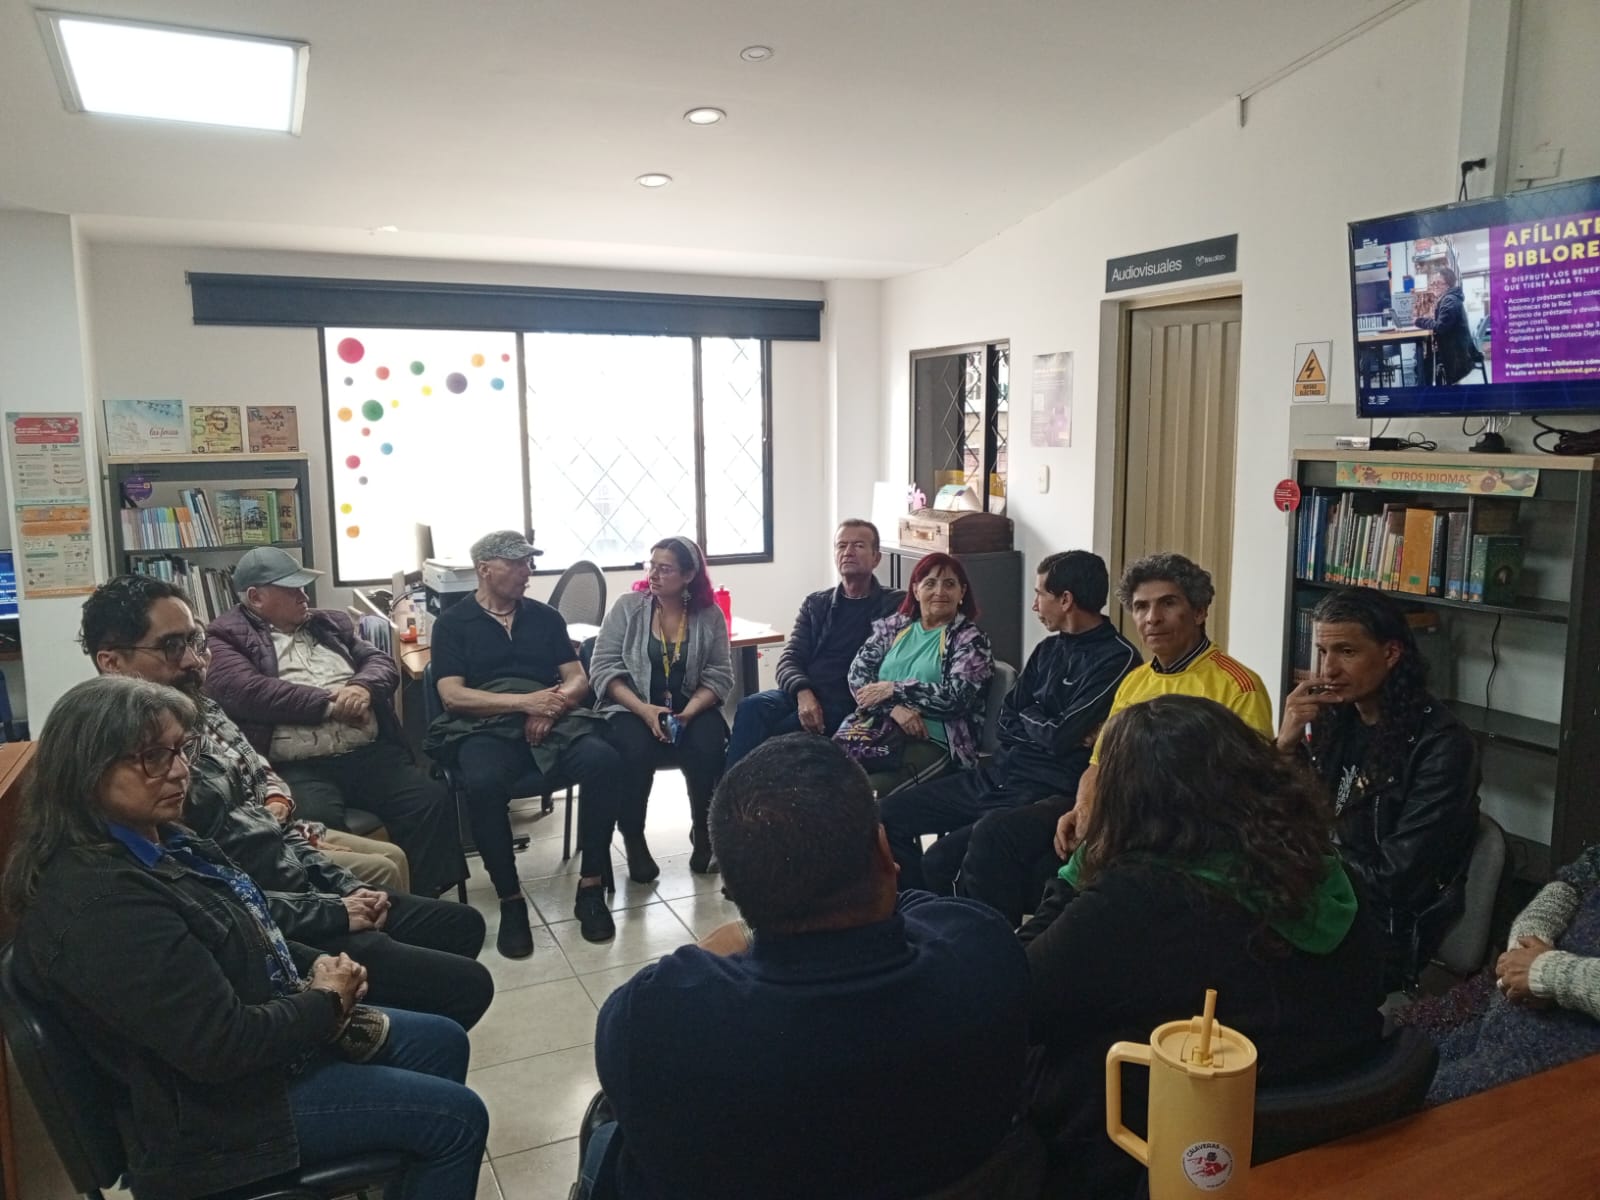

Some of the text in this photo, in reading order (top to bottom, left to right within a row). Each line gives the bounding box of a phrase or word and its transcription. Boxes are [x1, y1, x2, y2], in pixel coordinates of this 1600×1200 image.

[1504, 240, 1600, 269] BIBLORE
[1111, 259, 1182, 282] Audiovisuales
[1511, 273, 1550, 283] DISFRUTA
[1553, 270, 1570, 278] LOS
[1504, 284, 1520, 292] QUE
[1523, 280, 1546, 289] TIENE
[1549, 278, 1571, 286] PARA
[1508, 311, 1532, 319] Servicio
[1550, 331, 1582, 339] Biblioteca
[1391, 471, 1472, 484] OTROS IDIOMAS
[1186, 1143, 1220, 1157] CALAVERAS
